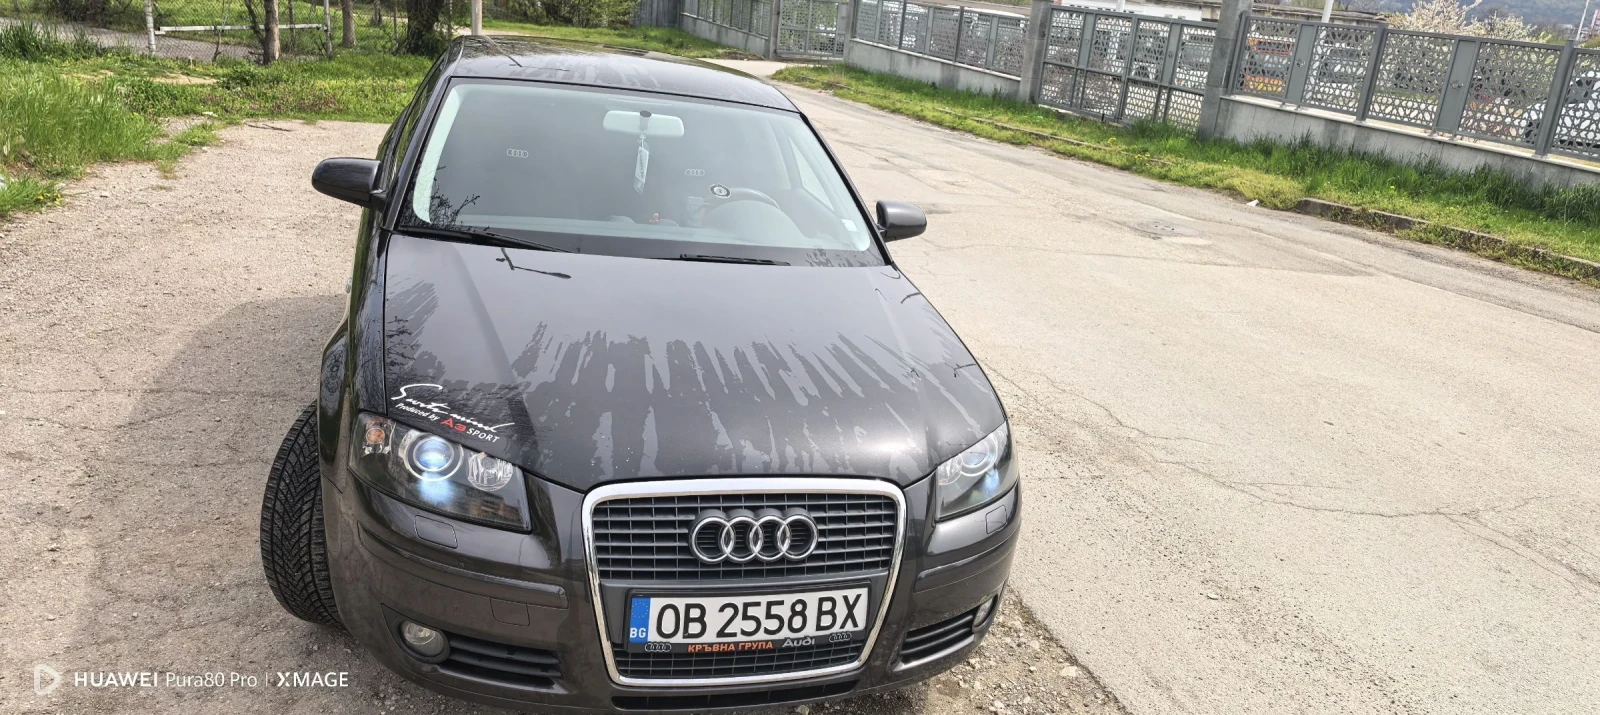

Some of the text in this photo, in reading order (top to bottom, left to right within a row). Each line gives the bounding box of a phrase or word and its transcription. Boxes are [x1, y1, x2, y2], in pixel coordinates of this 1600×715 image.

[395, 402, 500, 444] Produced by A3 SPORT
[716, 598, 807, 638] 2558
[630, 627, 646, 638] BG
[687, 641, 773, 653] КРЪВНА ГРУПА
[782, 637, 815, 648] Audi
